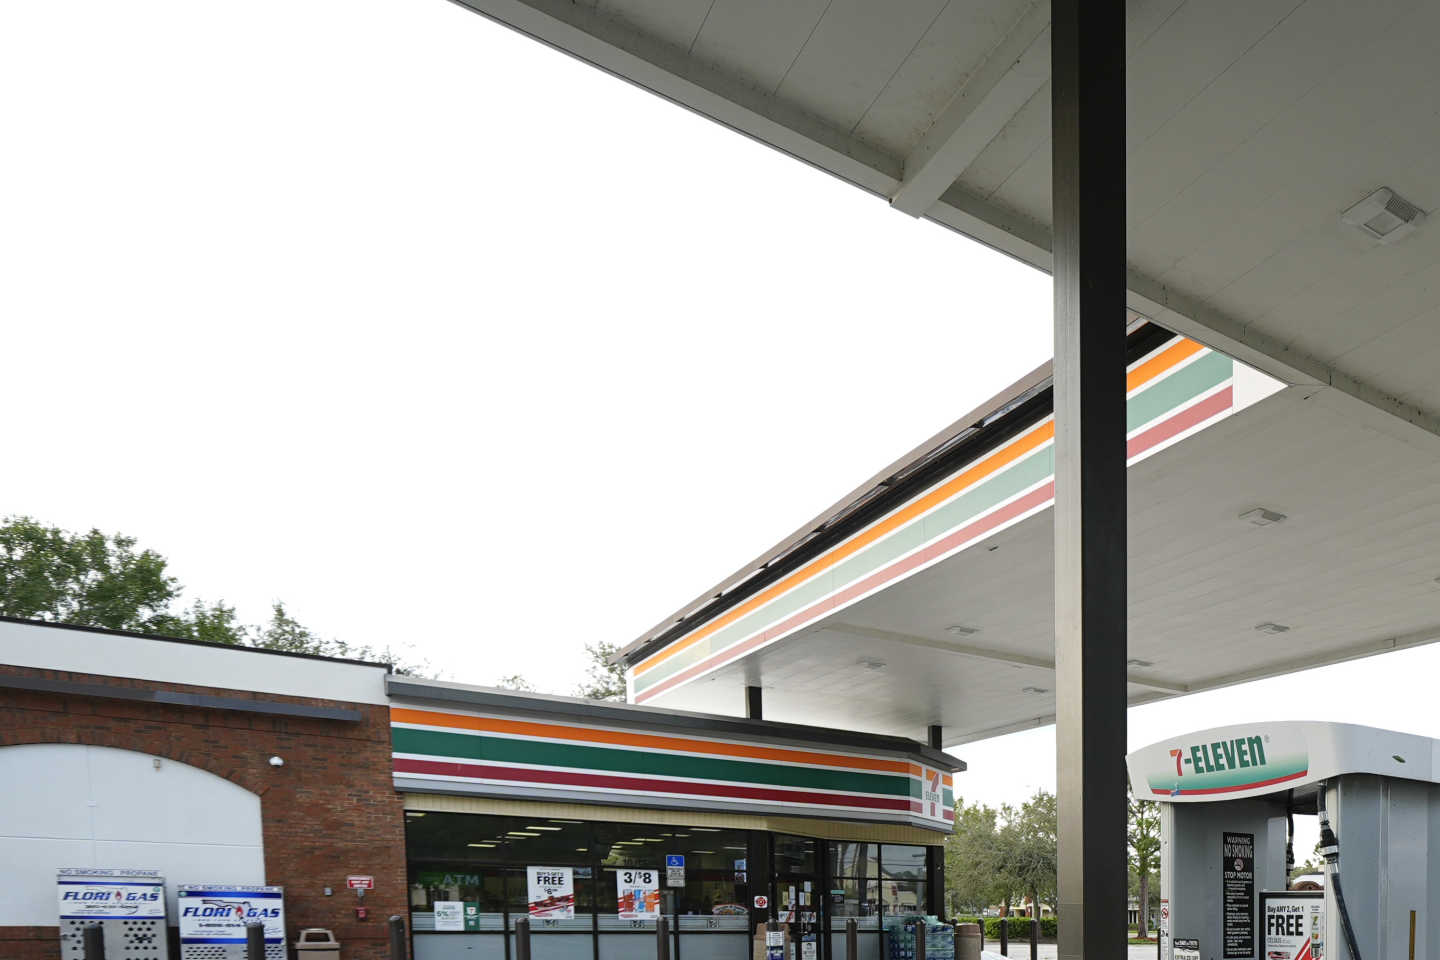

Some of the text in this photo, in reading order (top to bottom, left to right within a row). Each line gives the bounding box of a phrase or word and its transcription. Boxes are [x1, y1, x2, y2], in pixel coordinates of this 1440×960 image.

[1227, 836, 1250, 844] WARNING
[1224, 844, 1253, 858] NO SMOKING
[443, 874, 479, 886] ATM
[1225, 871, 1252, 879] STOP MOTOR
[537, 876, 564, 885] FREE
[63, 891, 160, 901] FLORI GAS
[182, 907, 280, 918] FLORI GAS
[1267, 905, 1276, 913] Buy
[1267, 914, 1304, 937] FREE
